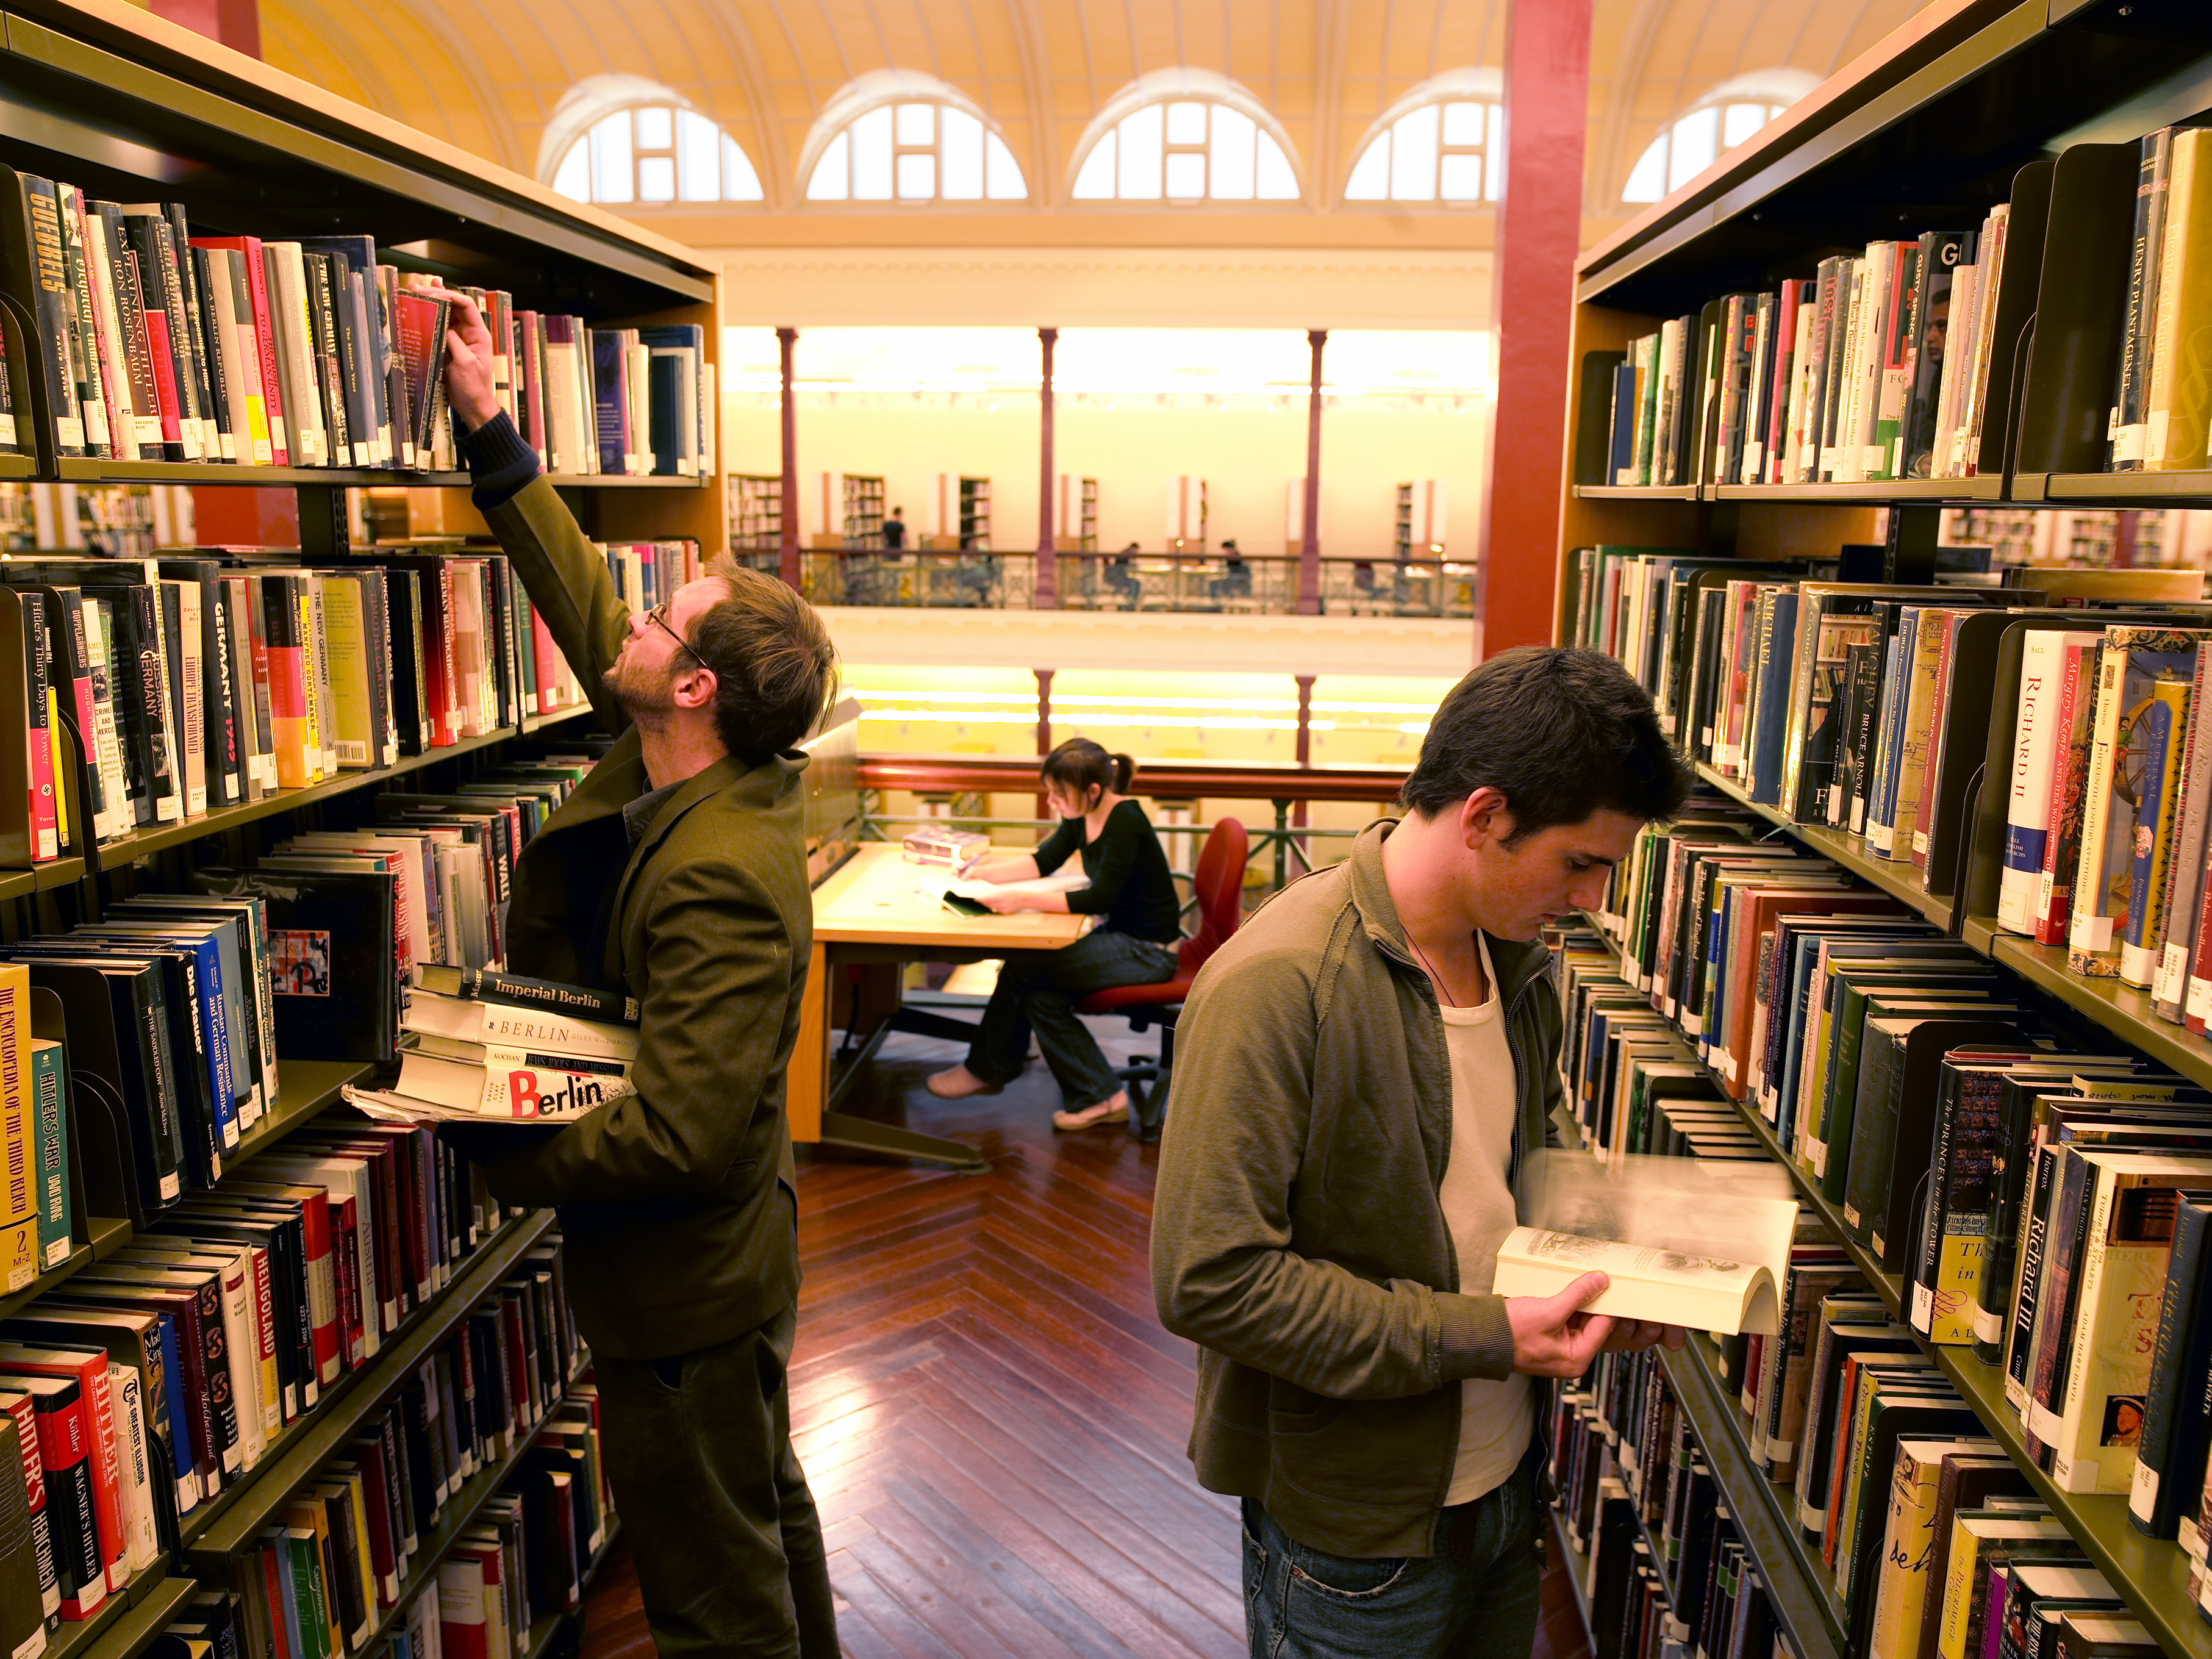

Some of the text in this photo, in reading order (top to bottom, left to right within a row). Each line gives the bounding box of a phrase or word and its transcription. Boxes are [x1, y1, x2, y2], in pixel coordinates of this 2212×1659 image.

[2174, 154, 2183, 186] OWEN
[30, 193, 66, 294] GOEBBELS
[85, 237, 94, 270] Warned
[90, 270, 95, 280] Us
[254, 249, 264, 295] JARAUSCH
[113, 259, 143, 384] RON ROSENBAUM
[118, 226, 145, 343] EXPLAINING
[140, 350, 157, 415] HITLER
[188, 274, 198, 307] German
[195, 310, 205, 357] Opposition
[201, 357, 206, 368] to
[260, 312, 266, 327] TO
[1908, 254, 1923, 342] GUSTY SPENCE
[2123, 236, 2146, 390] HENRY PLANTAGENET
[2153, 221, 2182, 390] Eleanor of Aquitaine
[208, 293, 227, 402] A BERLIN REPUBLIC
[262, 330, 273, 378] GERMAN
[1844, 301, 1857, 379] Black Operations
[153, 572, 170, 692] Entering Germany
[370, 592, 382, 651] TIMOTHY
[382, 575, 392, 643] UNCHAINED
[318, 639, 328, 687] GERMANY
[375, 655, 386, 708] GARTON
[1864, 612, 1883, 709] HAUGHEY
[1935, 628, 1947, 695] ENCYCLOPAEDIA
[2197, 648, 2206, 666] THE
[32, 602, 49, 765] Hitler's Thirty Days to Power
[185, 657, 198, 754] EUROPE TRANSFORMED
[1933, 696, 1938, 708] OF
[2061, 657, 2078, 712] Margery
[2191, 670, 2203, 720] MILITARY
[2015, 675, 2042, 798] RICHARD II
[2057, 717, 2071, 756] Kempe
[2101, 699, 2110, 726] Horrox
[2054, 760, 2063, 782] AND
[2182, 720, 2197, 776] CAMPAIGNS
[2178, 790, 2188, 811] THE
[2182, 776, 2189, 789] OF
[2081, 739, 2108, 895] FIFTEENTH-CENTURY ATTITUDES
[2173, 814, 2184, 841] WARS
[2171, 842, 2180, 858] OF
[2165, 878, 2175, 909] ROSES
[470, 969, 483, 998] Masur
[495, 978, 601, 1008] Imperial Berlin
[186, 965, 202, 1055] Die Mauer
[500, 1020, 570, 1042] BERLIN
[150, 1031, 160, 1067] SADDLED
[210, 1019, 221, 1062] German
[216, 1062, 228, 1117] Resistance
[216, 993, 233, 1094] Russian Commands
[493, 1053, 521, 1062] KOCHAN
[0, 986, 26, 1214] THE ENCYCLOPEDIA OF THE THIRD REICH
[509, 1070, 603, 1119] Berlin
[39, 1072, 60, 1171] HITLER'S WAR
[48, 1173, 63, 1222] DAVID IRVING
[1926, 1098, 1954, 1267] The PRINCES in the TOWER
[2041, 1154, 2052, 1191] Horrox
[2020, 1170, 2031, 1230] RICHARD
[2077, 1205, 2088, 1242] BRIGDEN
[2096, 1194, 2108, 1236] TUDORS
[13, 1253, 30, 1267] M-Z
[17, 1230, 27, 1253] 2
[362, 1220, 374, 1288] Austria
[1957, 1266, 1974, 1281] in
[2017, 1214, 2046, 1333] Richard III
[2087, 1244, 2099, 1291] STUARTS
[257, 1255, 274, 1355] HELIGOLAND
[1781, 1297, 1792, 1336] Polite
[144, 1327, 161, 1352] Mad
[145, 1346, 163, 1367] King
[1774, 1338, 1786, 1378] Tourist
[2070, 1310, 2088, 1403] ADAM HART-DAVIS
[68, 1415, 81, 1453] Köhler
[93, 1374, 119, 1485] HITLER
[123, 1378, 146, 1486] THE GREATEST ILLUSION
[200, 1384, 217, 1460] Motherland
[16, 1403, 57, 1595] HITLER'S HENCHMEN
[74, 1464, 96, 1580] WAGNER'S HITLER
[1880, 1561, 1889, 1599] PERKIN
[1945, 1575, 1956, 1617] GRACE
[1948, 1568, 1964, 1643] PILGRIMAGE
[2001, 1634, 2019, 1659] DEREK
